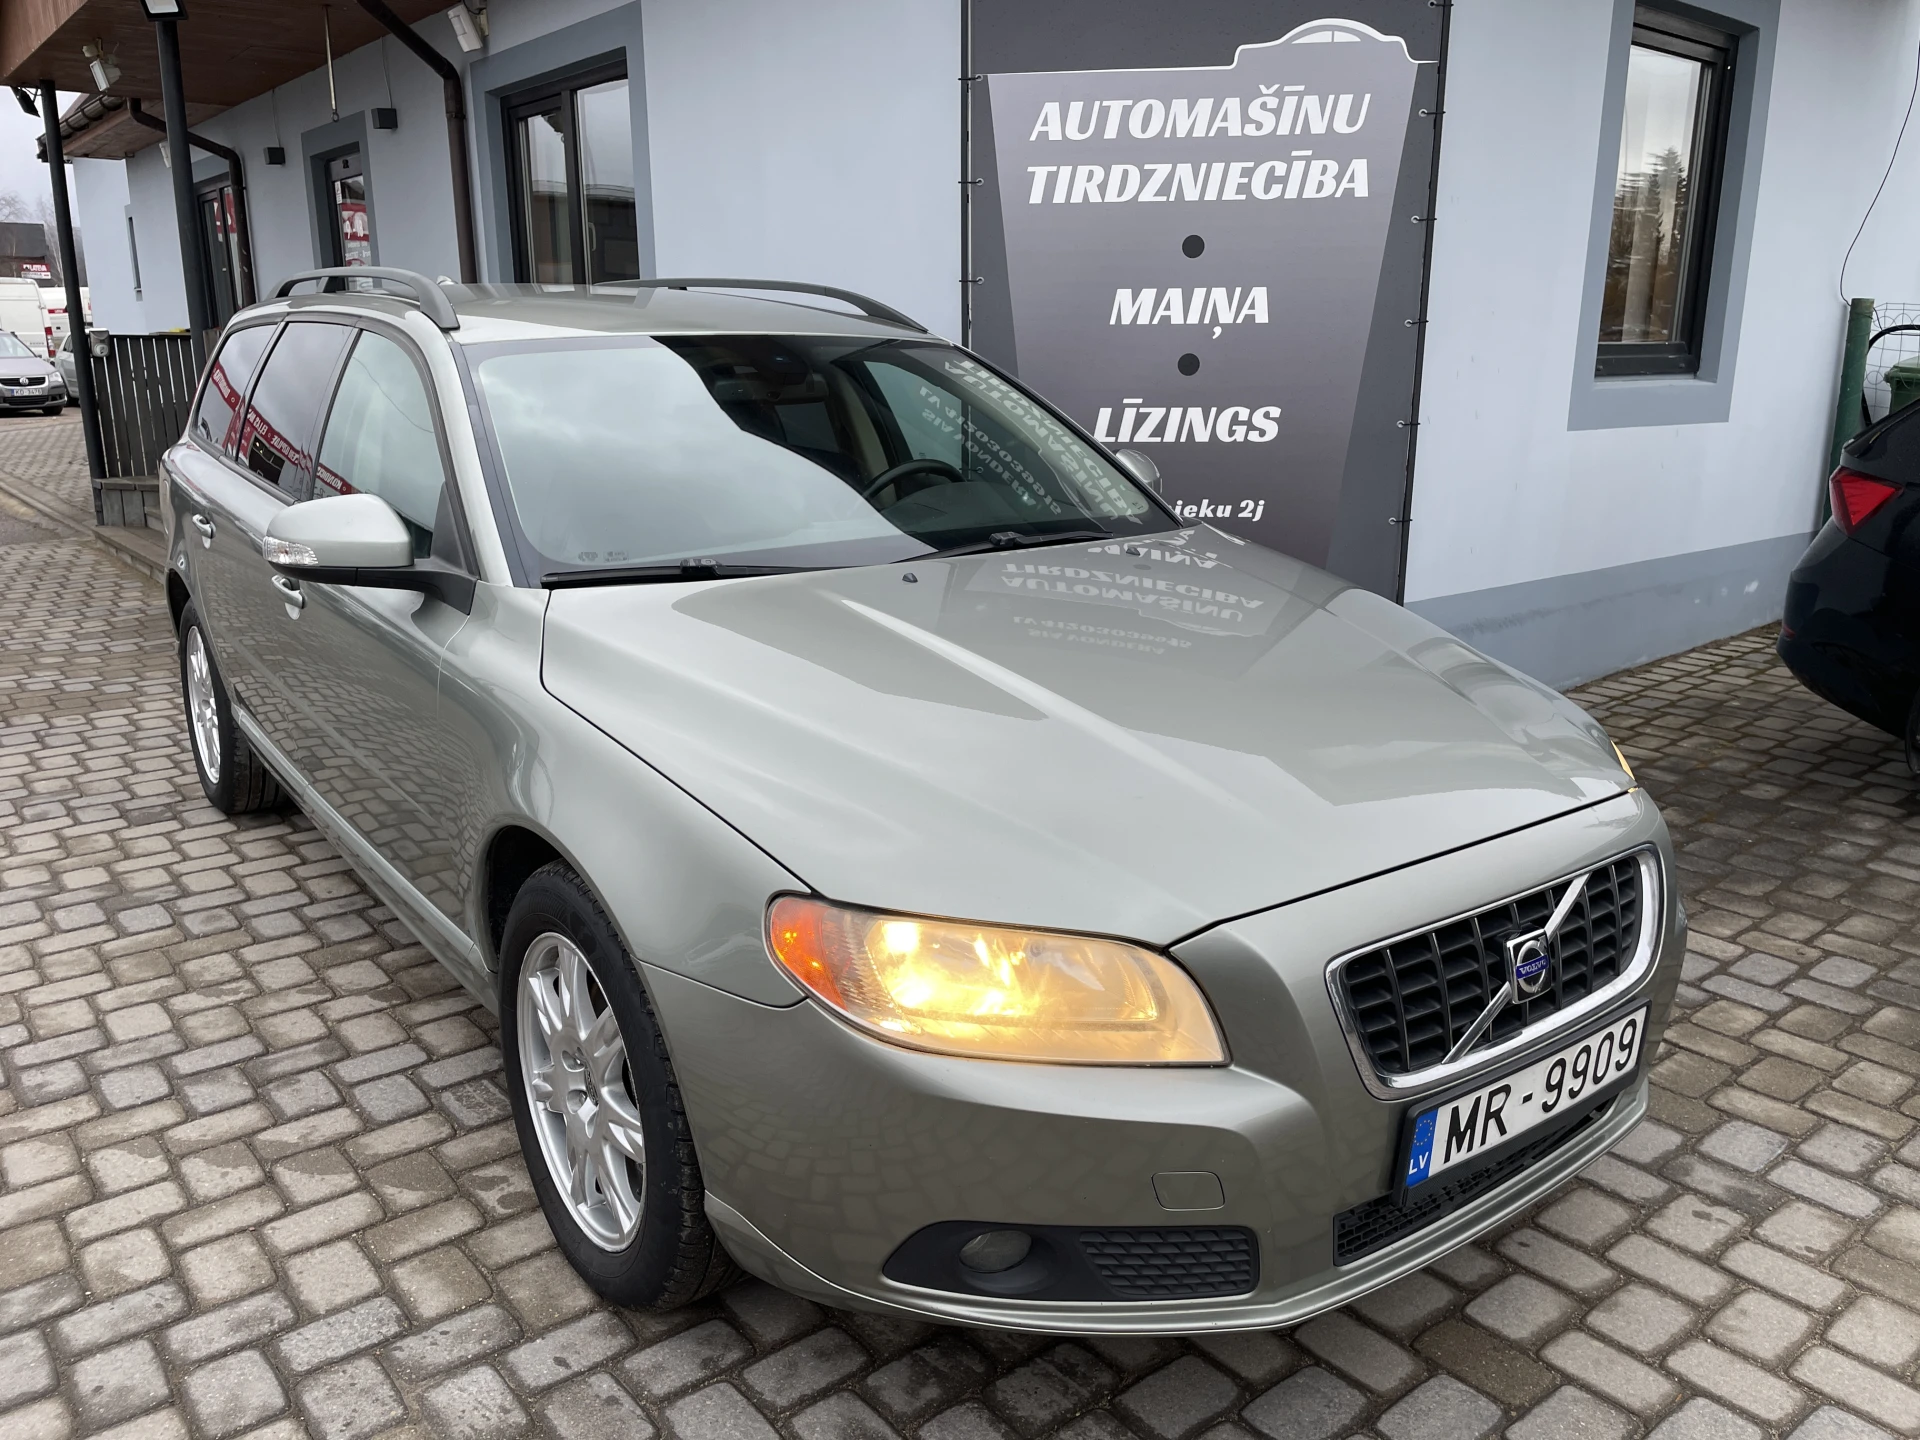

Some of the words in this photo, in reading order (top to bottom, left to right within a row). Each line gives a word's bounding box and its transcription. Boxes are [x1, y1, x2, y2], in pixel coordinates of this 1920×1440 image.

[1029, 84, 1371, 141] AUTOMAŠĪNU
[1026, 150, 1370, 204] TIRDZNIECĪBA
[1109, 286, 1269, 339] MAIŅA
[1094, 398, 1281, 443] LĪZINGS
[1168, 499, 1232, 518] ieku
[1238, 500, 1265, 522] 2j
[1518, 959, 1547, 975] VOLVO
[1443, 1018, 1638, 1165] MR-9909
[1408, 1150, 1430, 1175] LV
